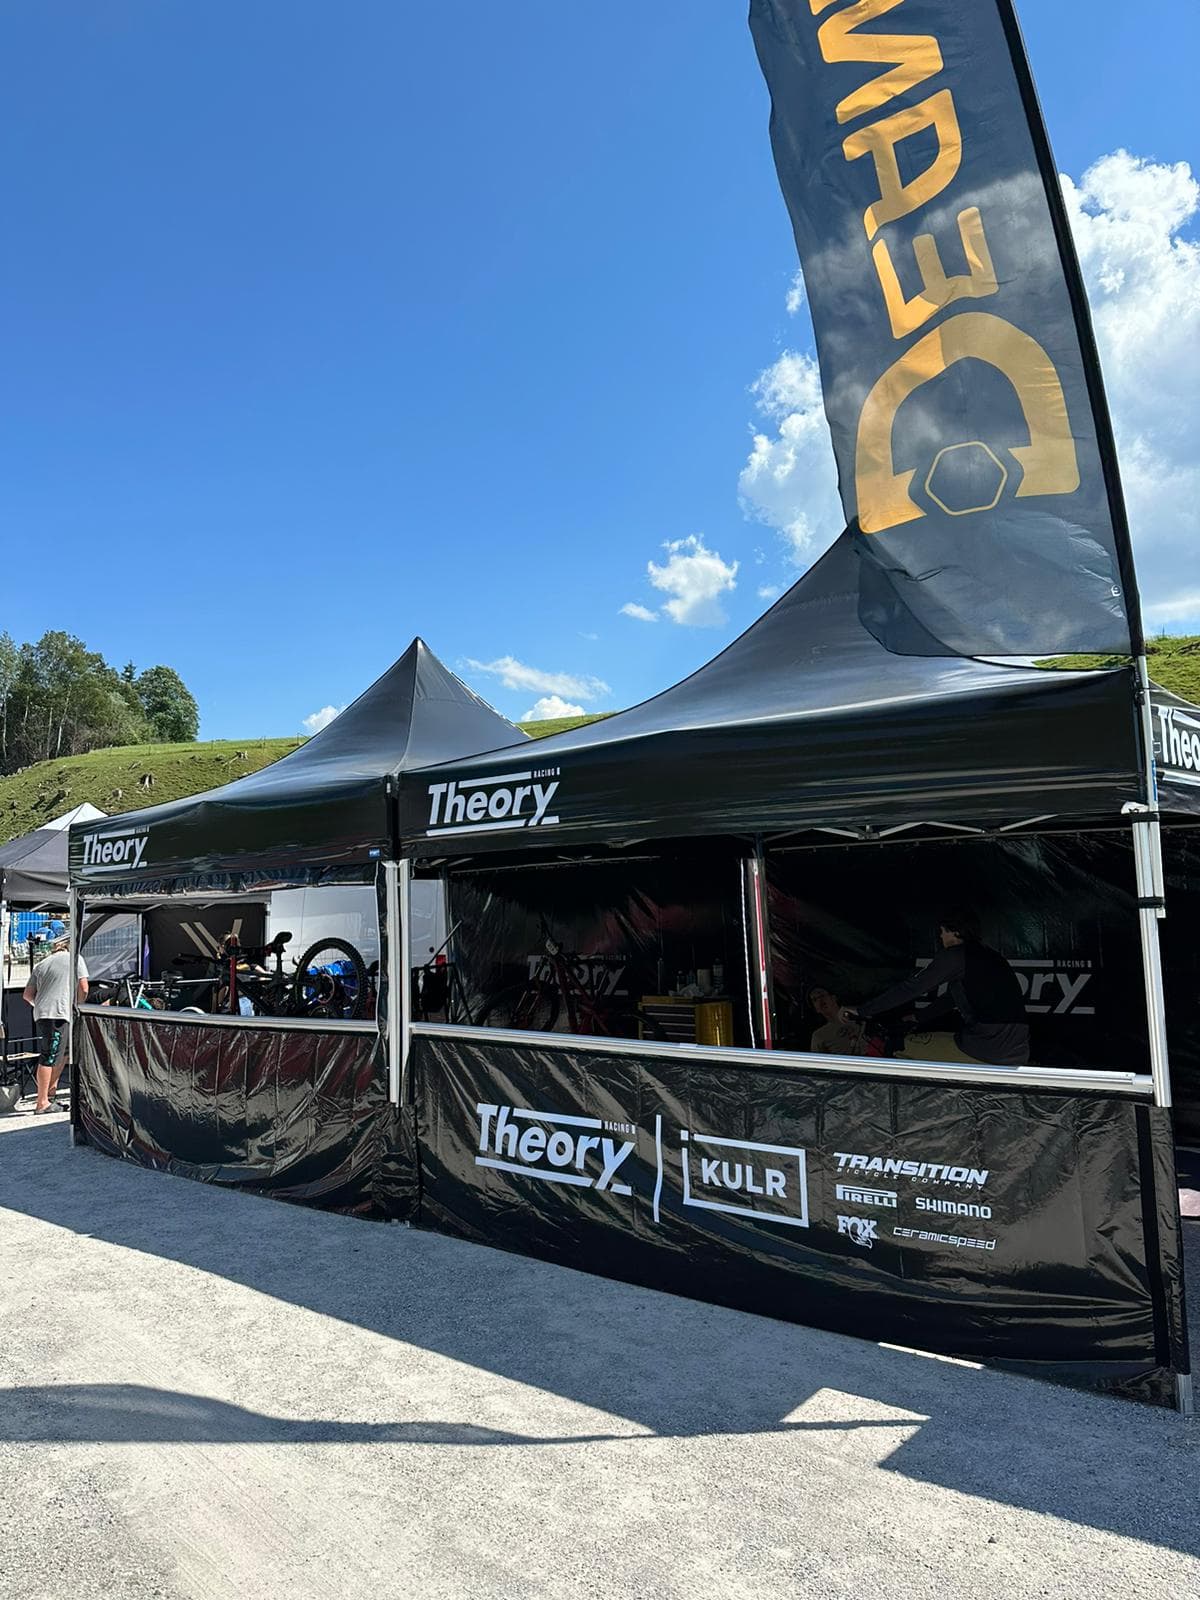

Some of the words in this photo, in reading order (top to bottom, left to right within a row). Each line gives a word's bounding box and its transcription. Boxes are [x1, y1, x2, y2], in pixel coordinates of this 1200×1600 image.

[1158, 706, 1200, 772] Theo
[428, 781, 560, 826] Theory
[83, 834, 149, 869] Theory
[527, 955, 626, 996] Thory
[476, 1102, 636, 1190] Theory
[701, 1157, 787, 1199] KULR
[833, 1151, 989, 1185] TRANSITION
[836, 1167, 899, 1180] BICYCLE
[911, 1176, 984, 1190] COMPANY
[836, 1184, 898, 1208] PIRELLI
[915, 1196, 992, 1219] SHIMANO
[836, 1214, 879, 1243] FOX
[893, 1226, 997, 1251] ceramicspeed
